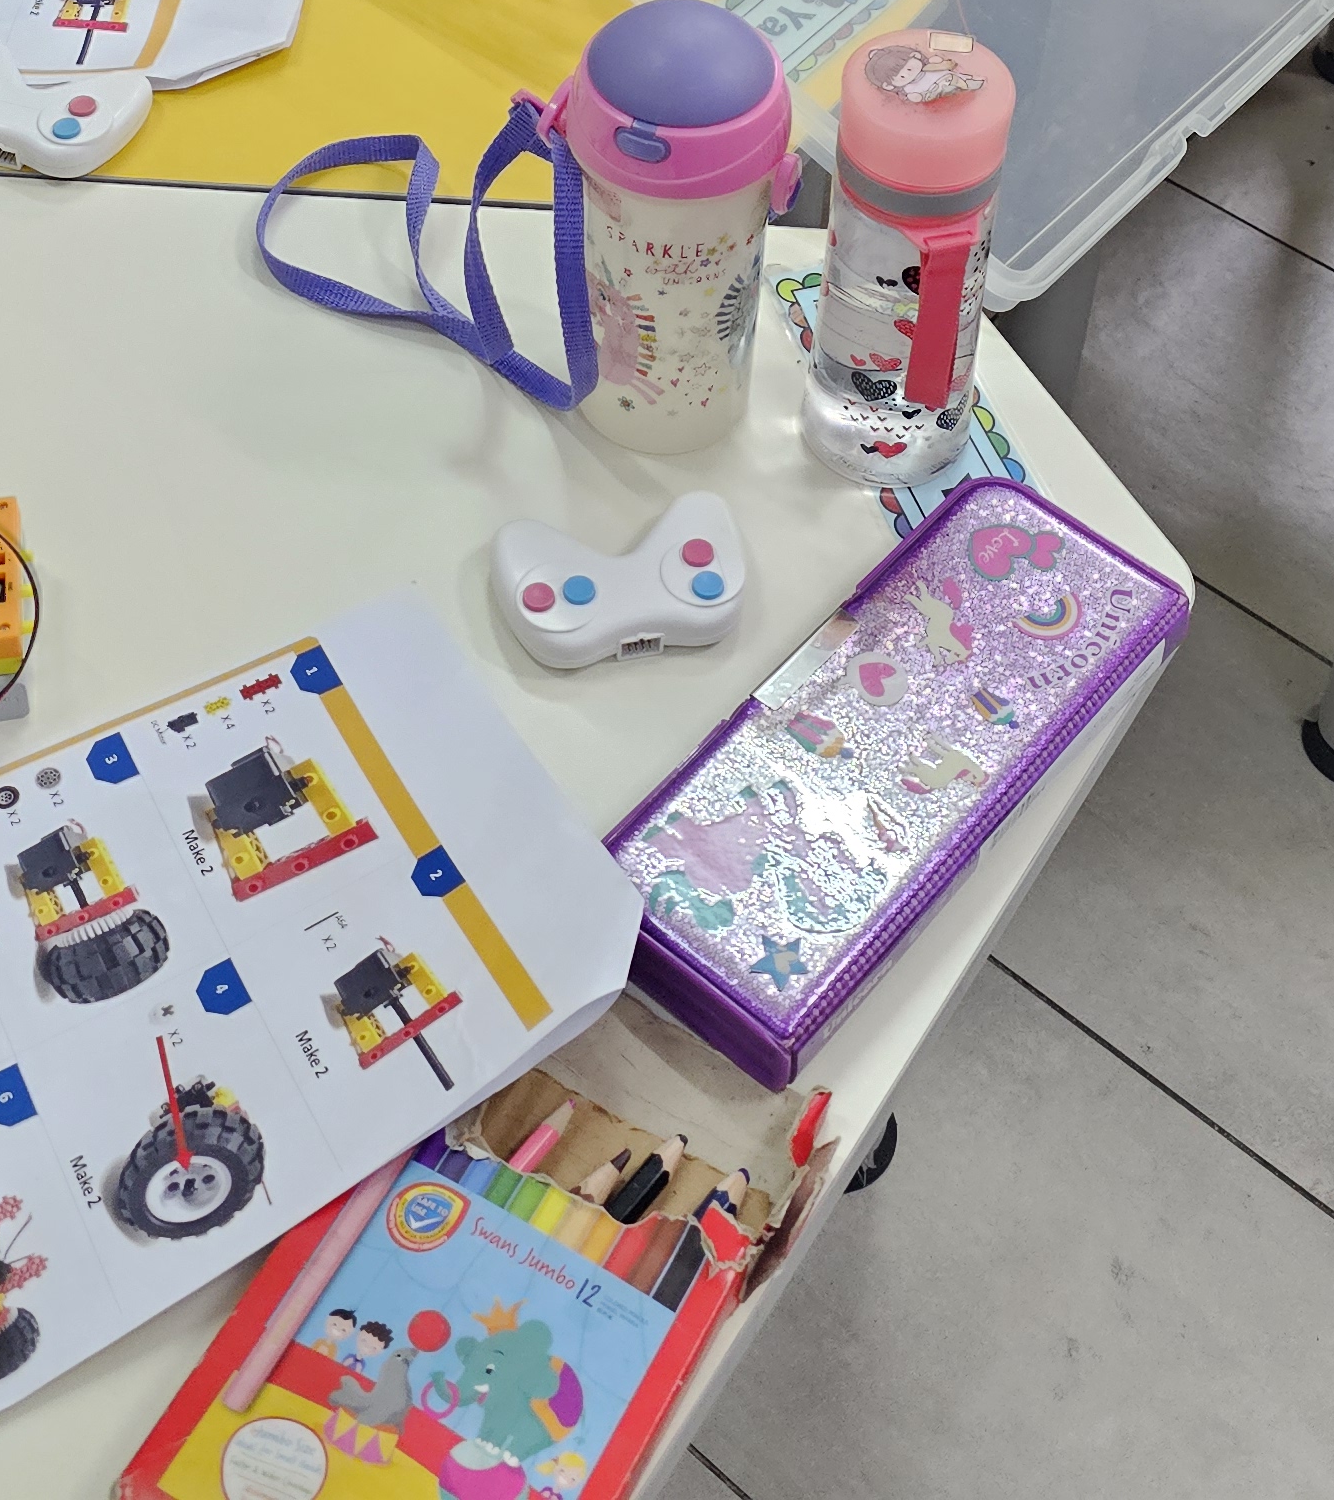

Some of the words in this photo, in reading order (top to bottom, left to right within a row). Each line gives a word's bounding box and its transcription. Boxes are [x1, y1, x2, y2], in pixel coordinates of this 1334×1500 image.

[606, 225, 705, 260] SPARKLE
[645, 259, 699, 276] with
[978, 528, 1020, 565] Love
[1026, 588, 1135, 690] Unicorn
[305, 666, 319, 676] 1
[104, 753, 118, 765] 3
[181, 829, 206, 865] Make
[200, 865, 214, 876] 2
[429, 869, 443, 881] 2
[295, 1030, 320, 1068] Make
[315, 1067, 329, 1079] 2
[70, 1155, 95, 1196] Make
[87, 1196, 102, 1209] 2
[470, 1215, 519, 1258] Swans
[519, 1246, 576, 1291] Jumbo
[574, 1277, 602, 1308] 12
